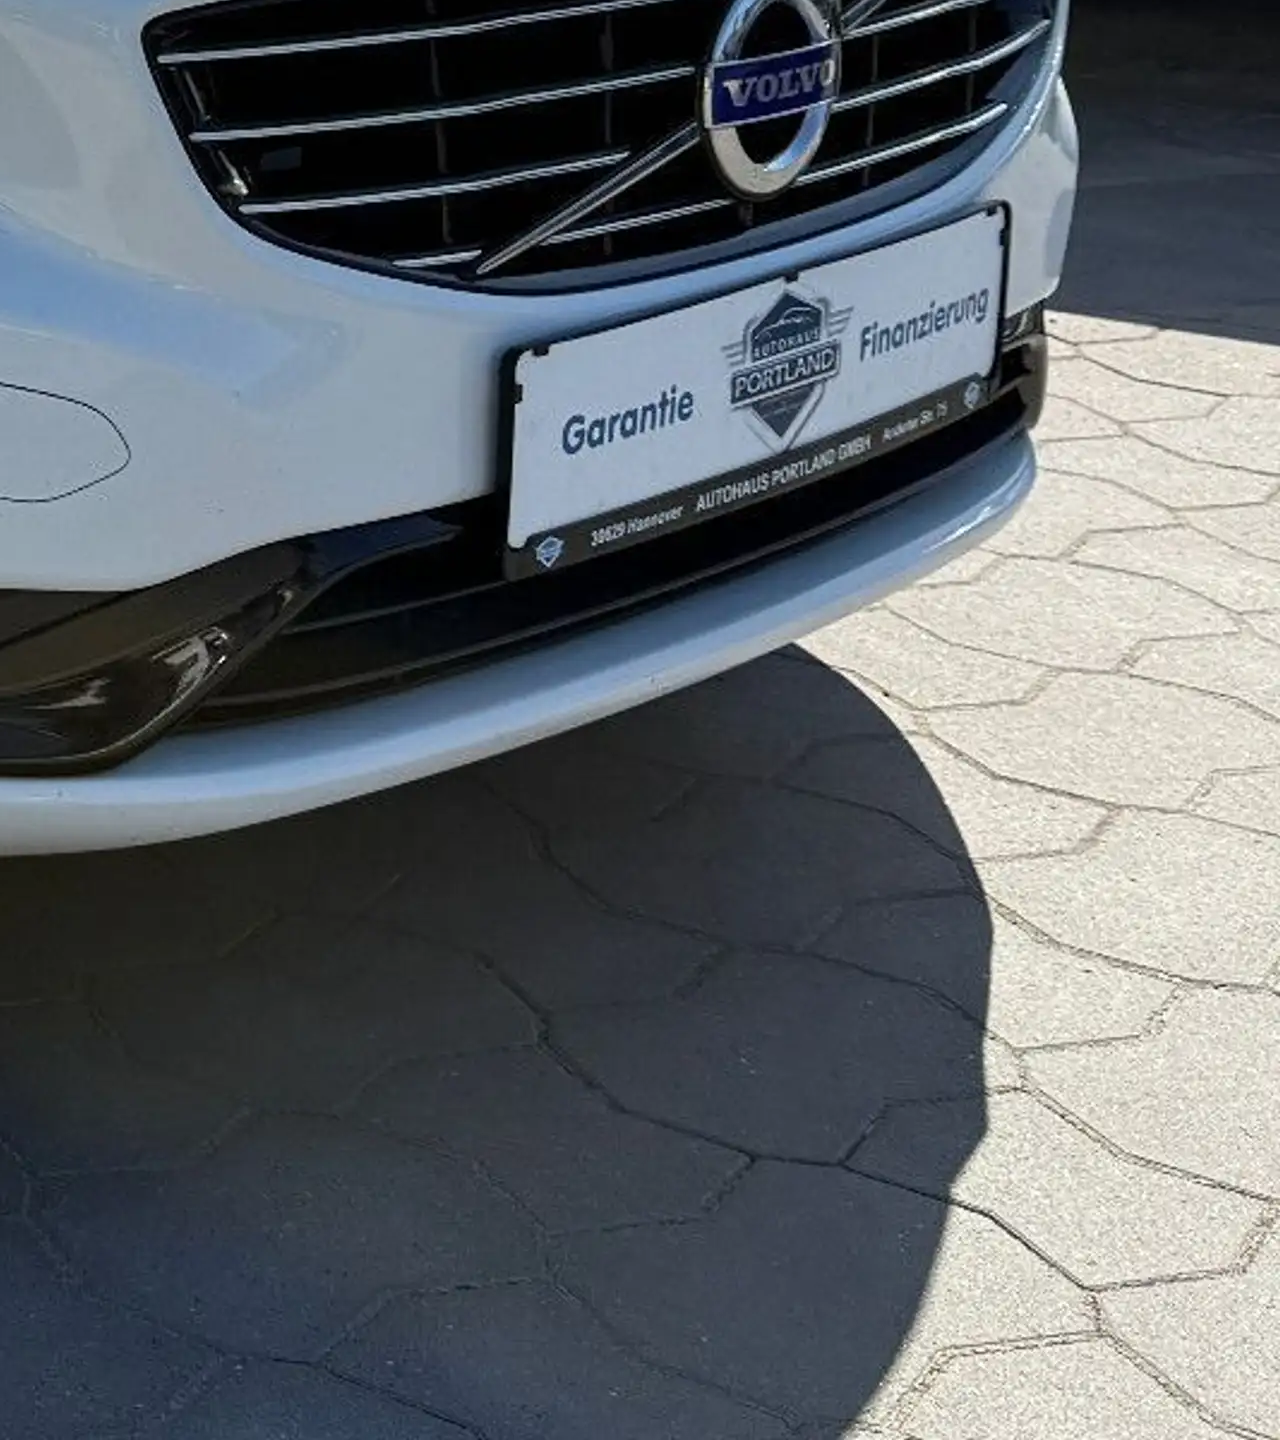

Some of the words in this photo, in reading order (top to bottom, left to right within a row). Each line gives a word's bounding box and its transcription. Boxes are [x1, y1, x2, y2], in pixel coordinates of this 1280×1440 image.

[723, 59, 836, 107] VOLVO
[860, 287, 989, 361] Finanzierung
[734, 348, 836, 399] PORTLAND
[562, 385, 695, 455] Garantie
[696, 474, 770, 511] AUTOHAUS
[771, 448, 836, 486] PORTLAND
[838, 434, 872, 462] GMBH
